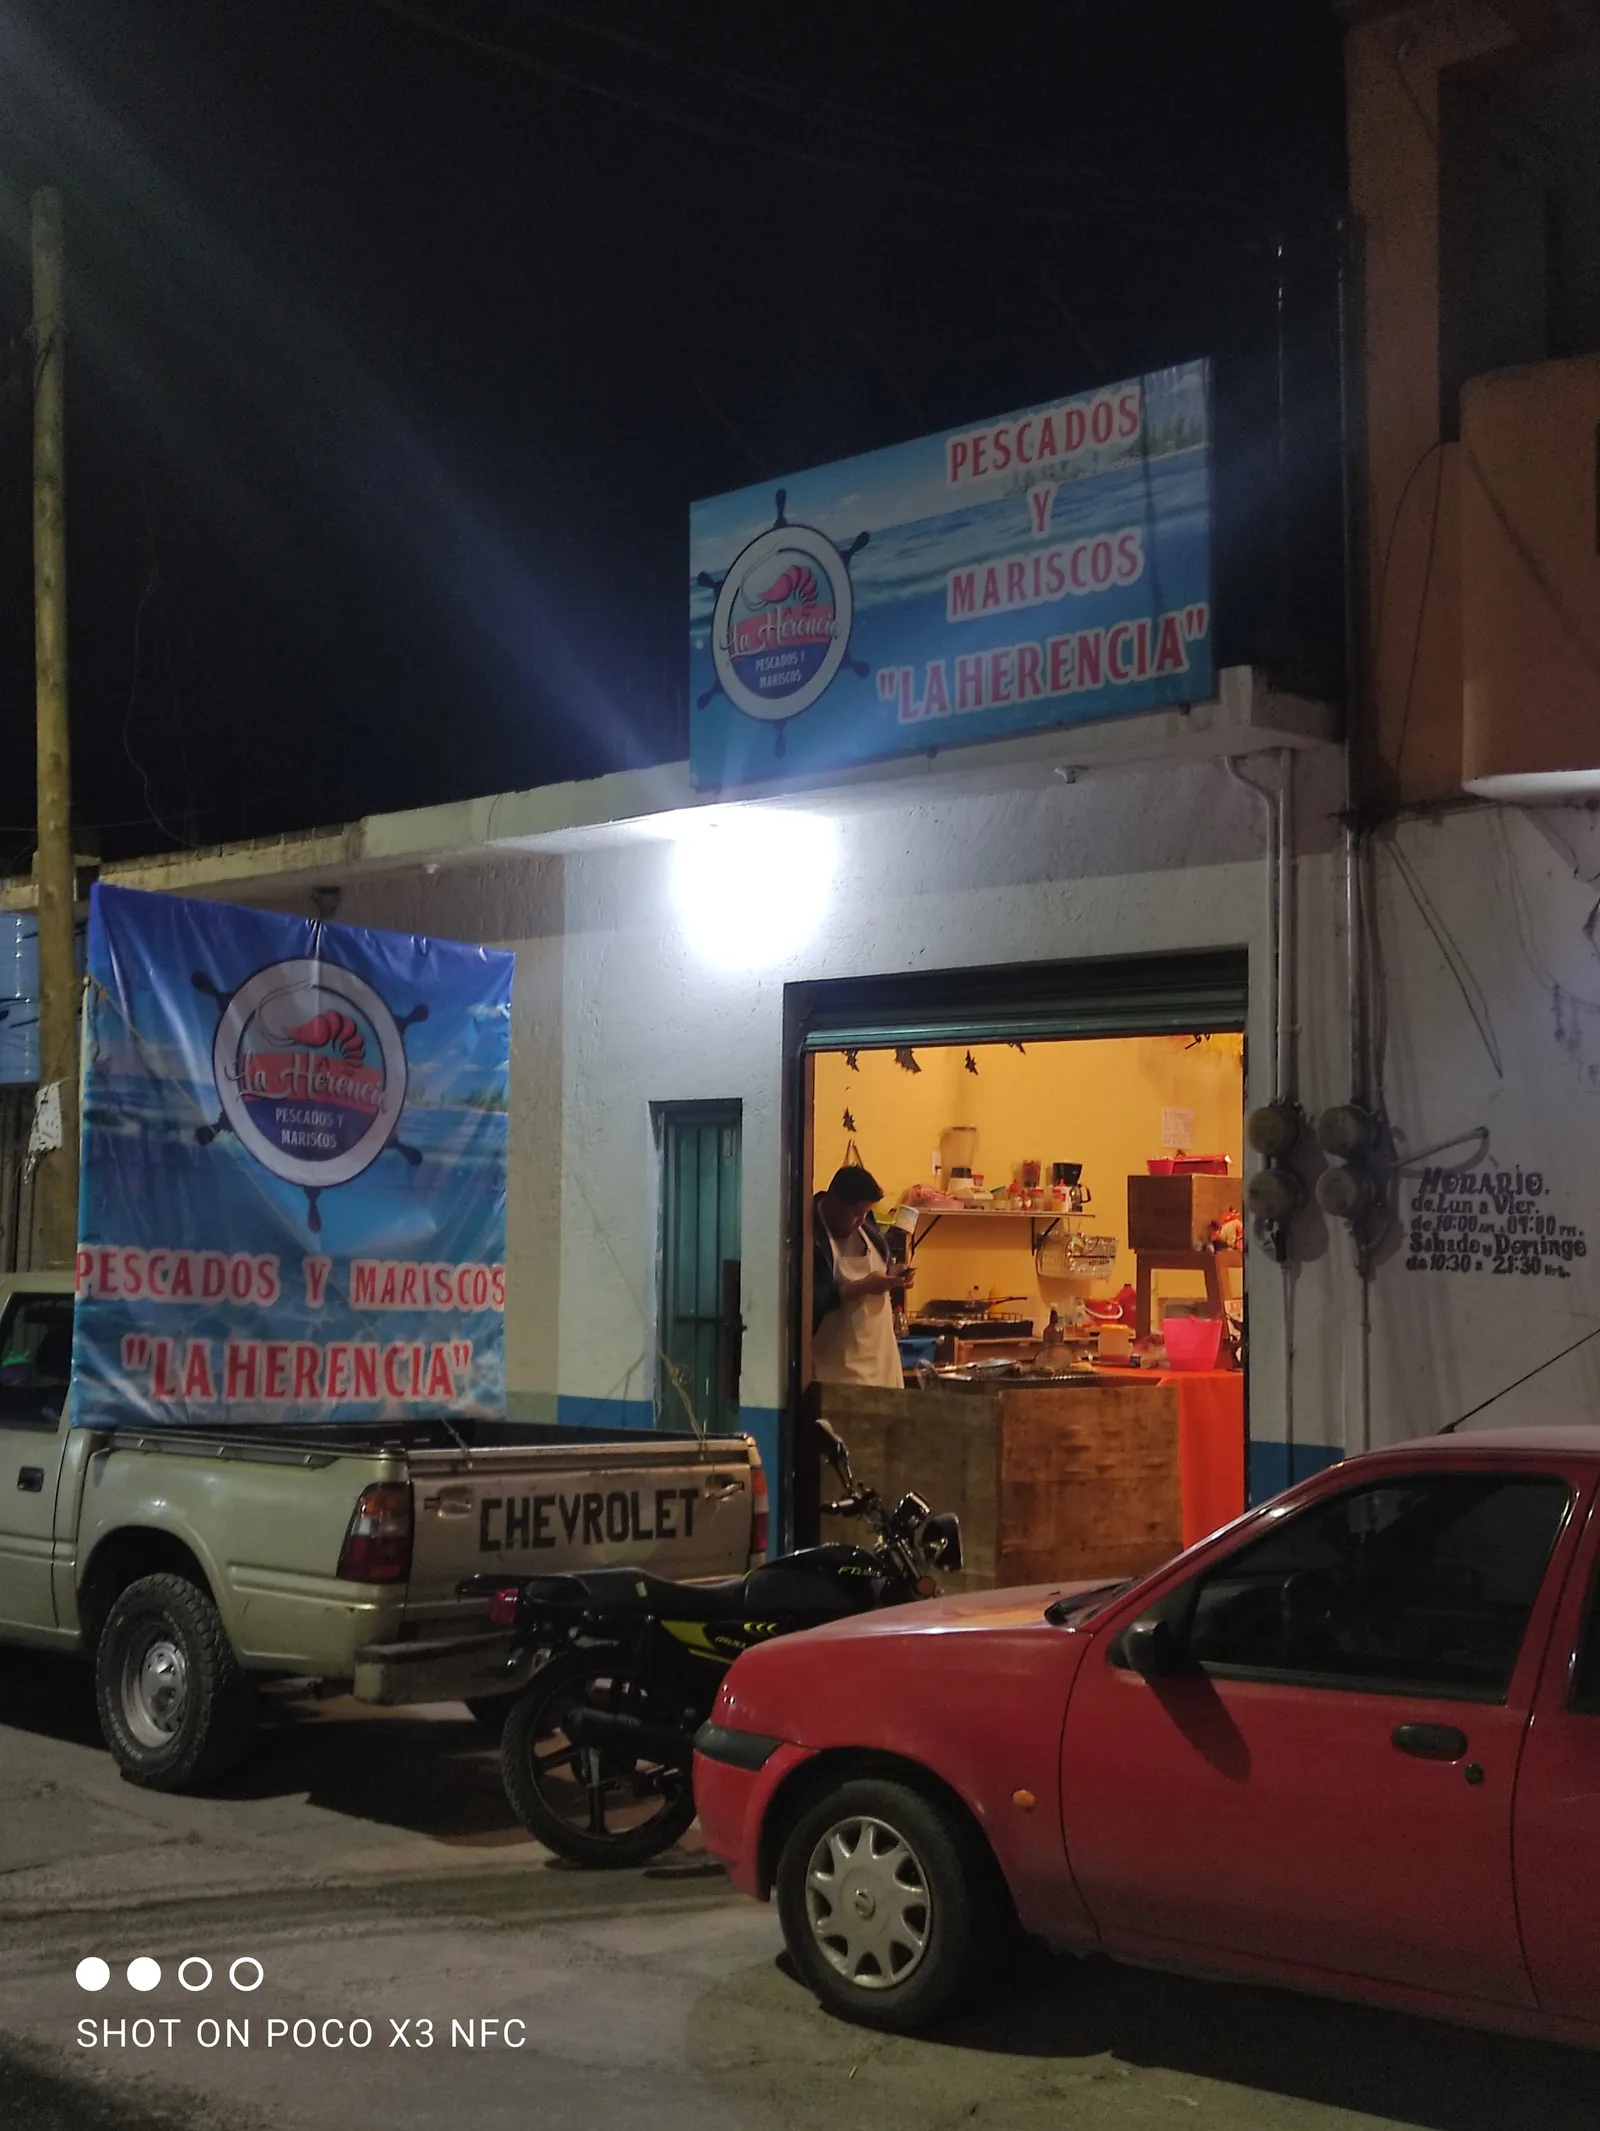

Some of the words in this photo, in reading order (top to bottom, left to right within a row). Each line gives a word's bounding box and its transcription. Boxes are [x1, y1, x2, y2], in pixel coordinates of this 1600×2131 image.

[949, 392, 1140, 483] PESCADOS
[1031, 488, 1051, 533] Y
[949, 534, 1140, 616] MARISCOS
[755, 652, 799, 672] PESCADOS
[760, 670, 802, 688] MARISCOS
[275, 1107, 334, 1127] PESCADOS
[337, 1113, 345, 1128] Y
[281, 1130, 337, 1148] MARISCOS
[1493, 1234, 1587, 1261] Domingo
[75, 1250, 276, 1299] PESCADOS
[306, 1260, 331, 1301] Y
[354, 1265, 506, 1307] MARISCOS
[1492, 1256, 1542, 1275] 21:30
[480, 1489, 699, 1552] CHEVROLET
